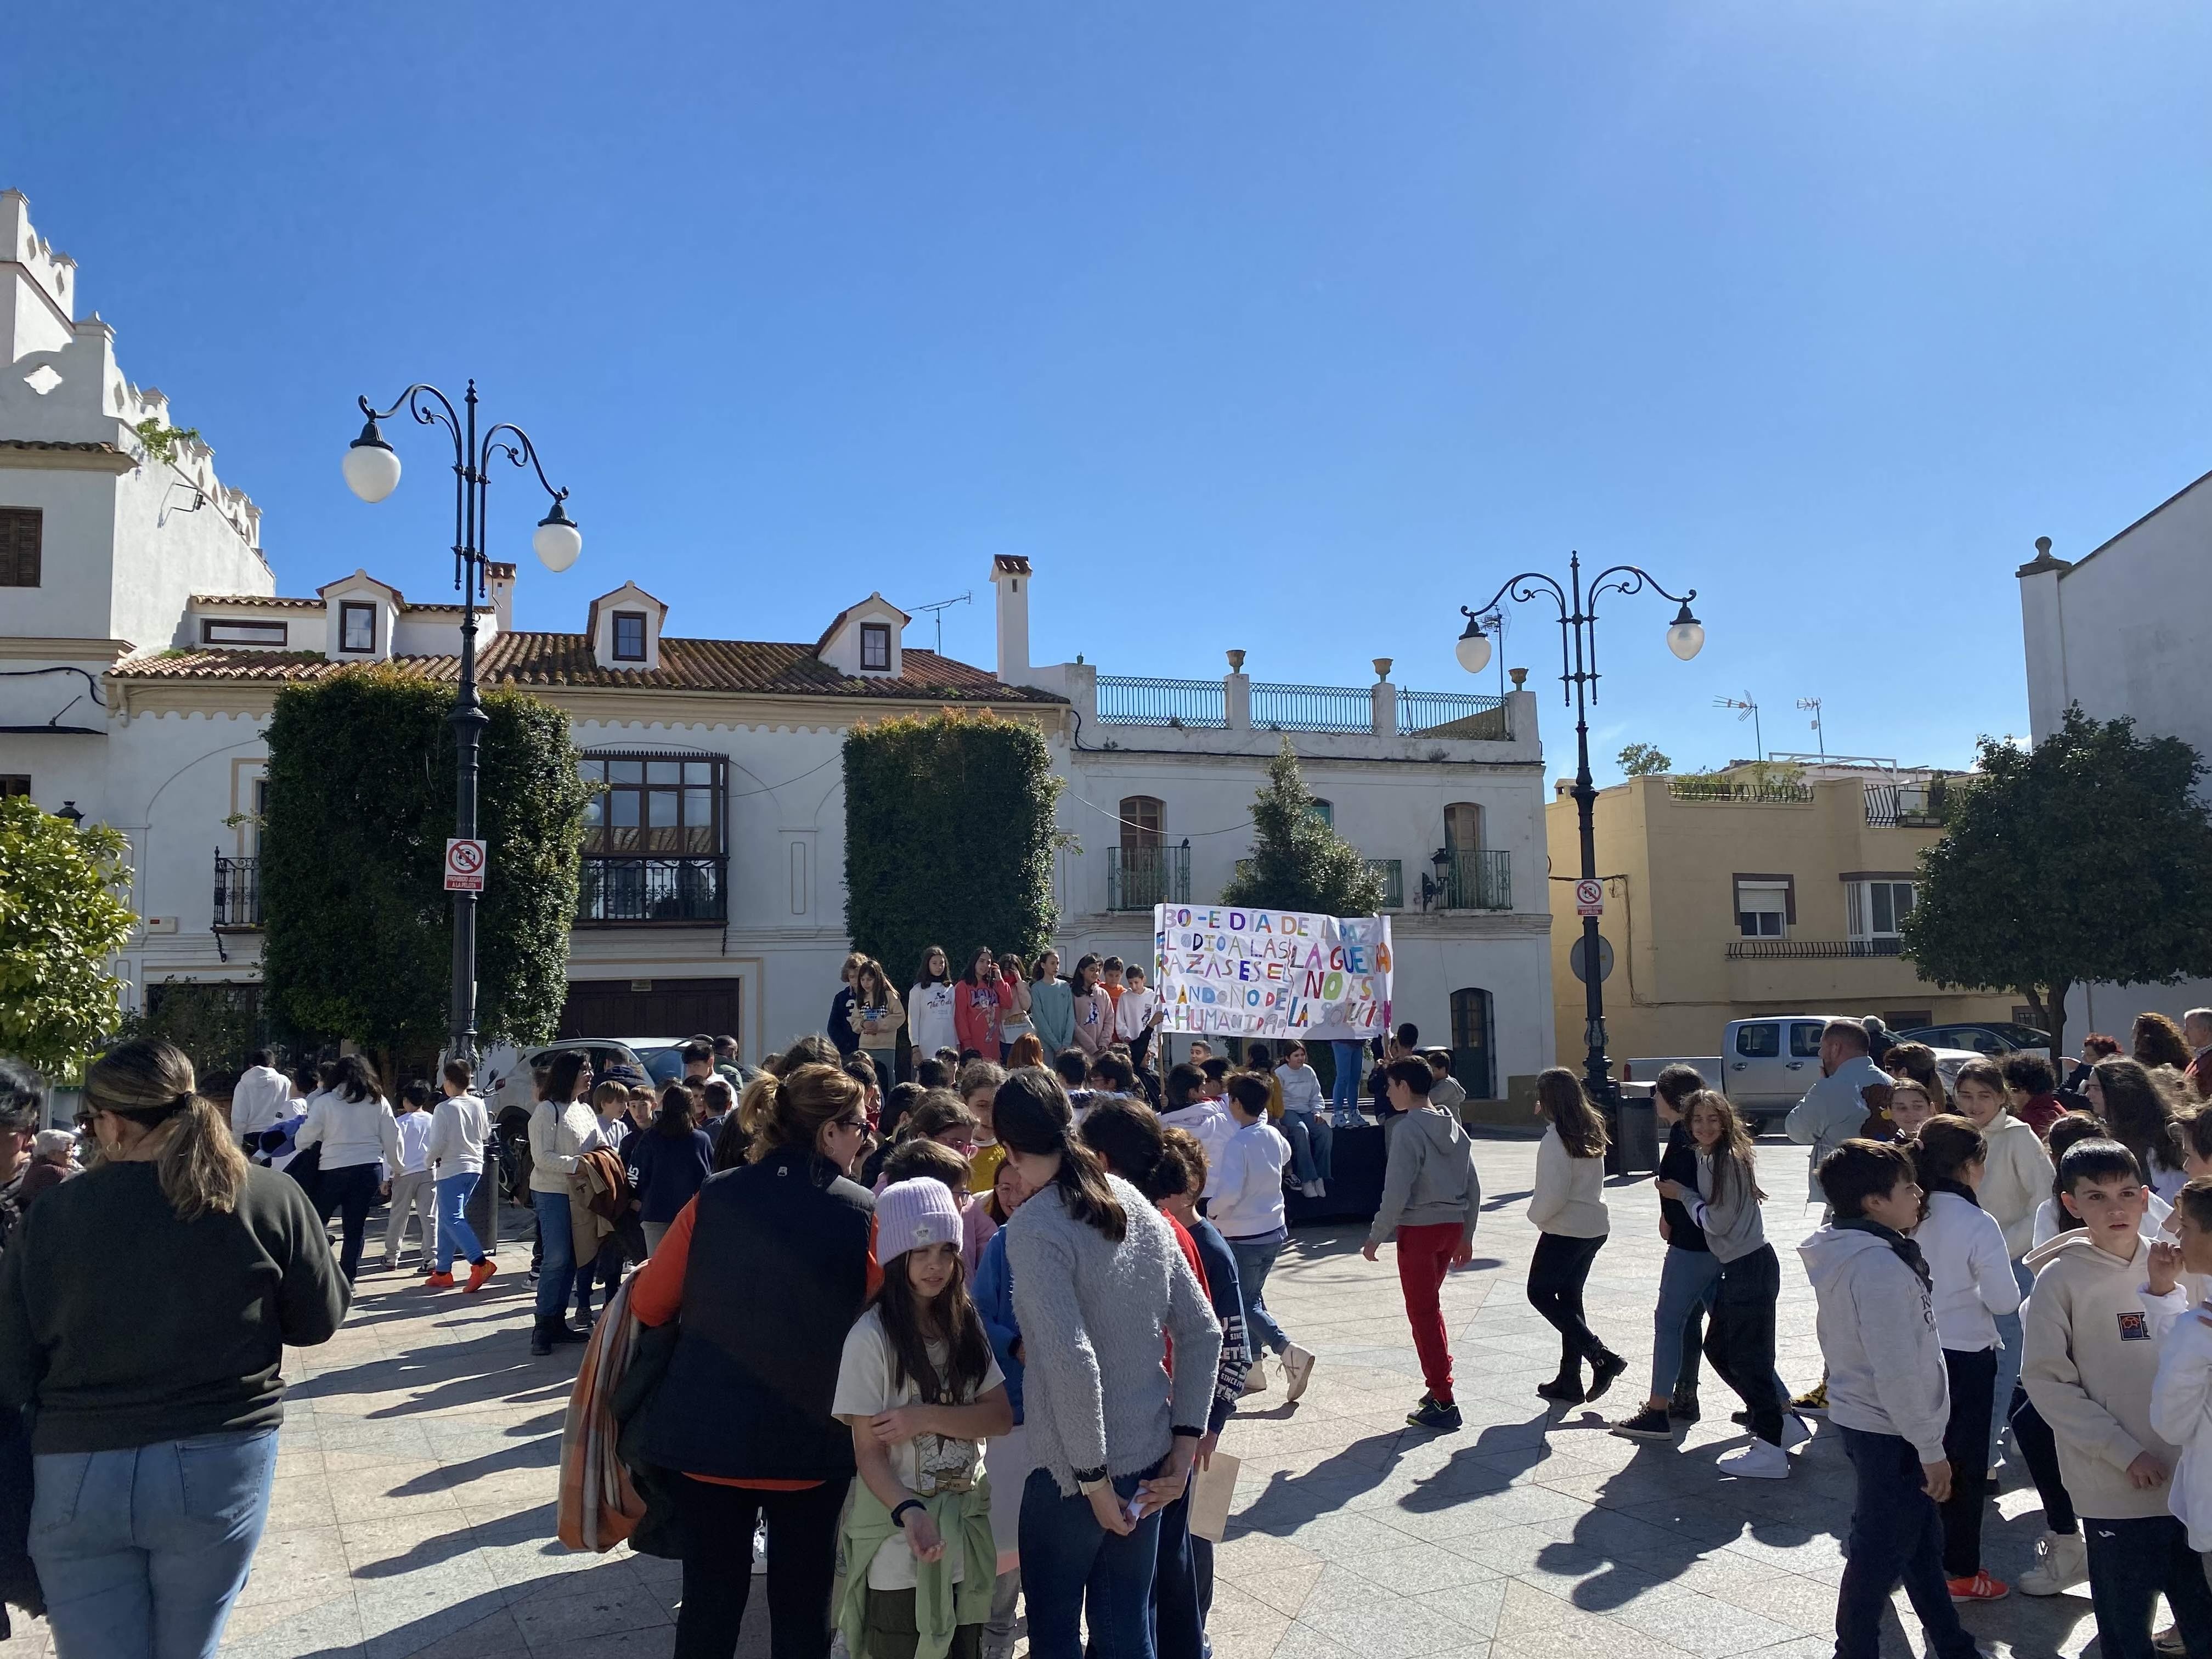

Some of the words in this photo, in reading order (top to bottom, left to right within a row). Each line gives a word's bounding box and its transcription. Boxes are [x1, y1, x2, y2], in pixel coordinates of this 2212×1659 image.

[1281, 916, 1310, 936] DE
[1156, 931, 1177, 950] EL
[1181, 933, 1226, 951] ODIO
[1228, 936, 1243, 959] A
[1251, 938, 1288, 960] LAS
[1290, 943, 1323, 970] LA
[1155, 953, 1233, 978] RAZAS
[1239, 960, 1261, 983] ES
[1267, 963, 1289, 983] EL
[1154, 984, 1260, 1009] ABANDONO
[1265, 988, 1289, 1011] DE
[1304, 970, 1343, 1000] NO
[1345, 974, 1374, 1001] ES
[1175, 1005, 1286, 1034] HUMANIDAD
[1288, 996, 1308, 1028] LA
